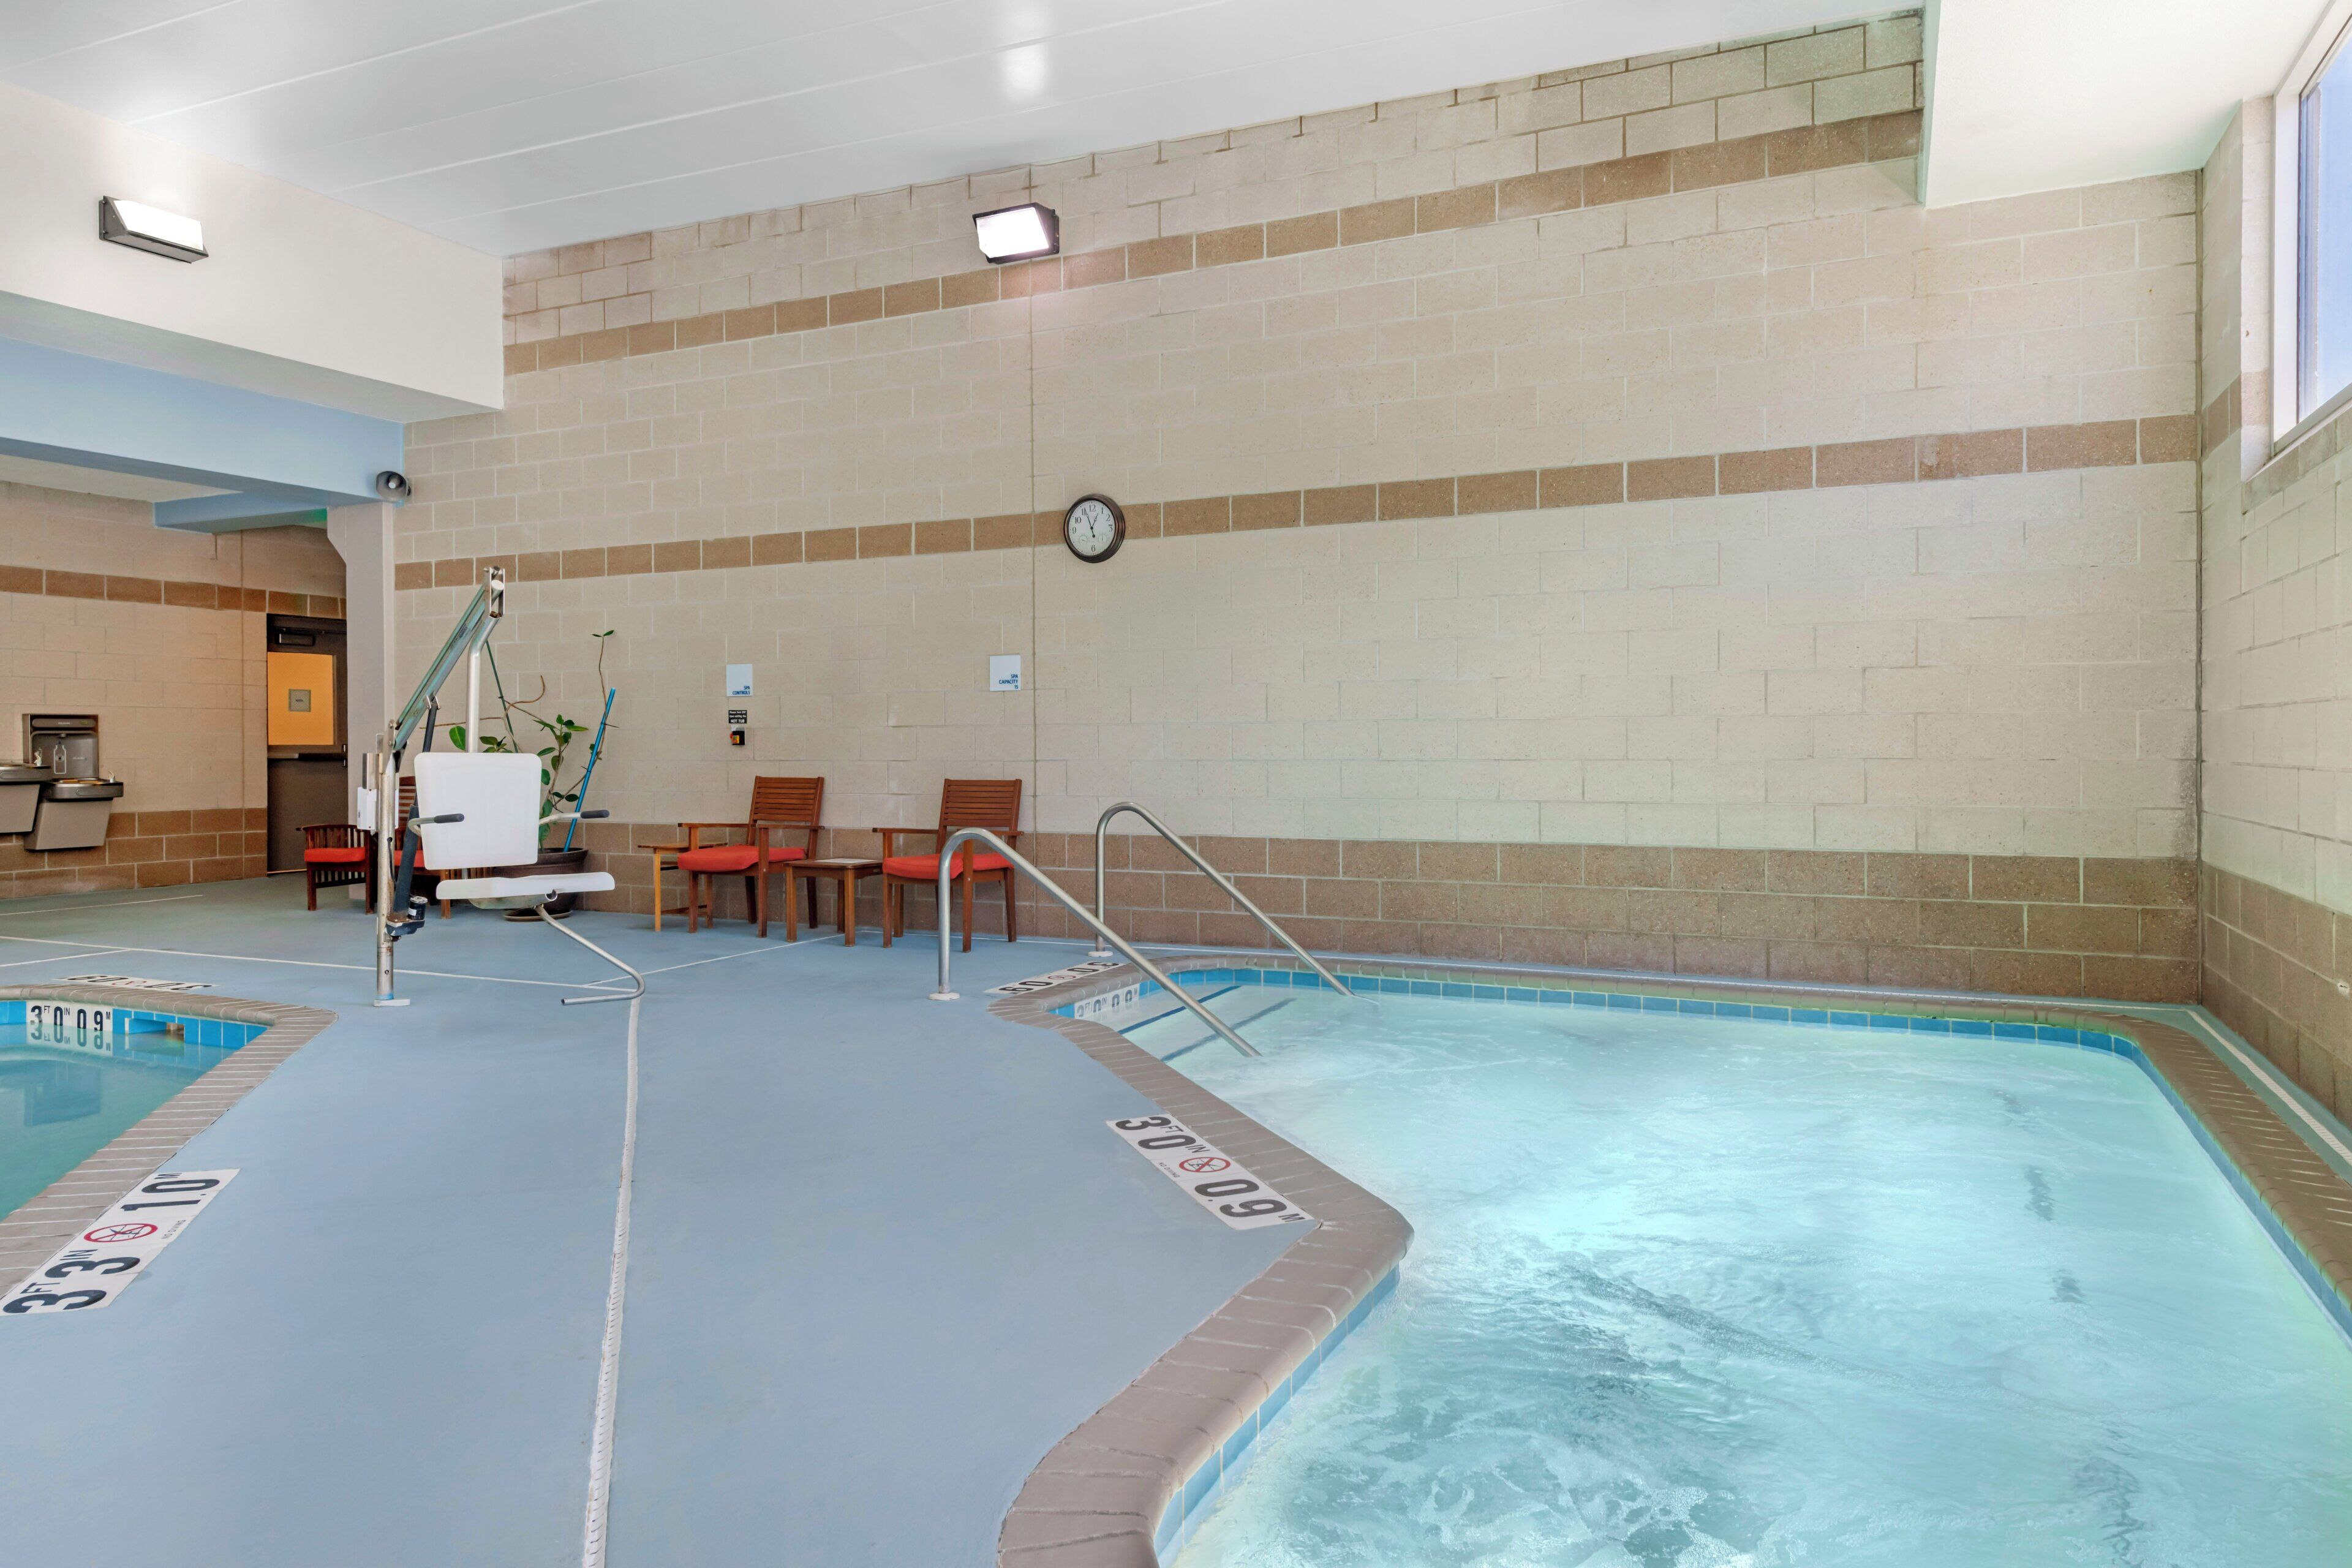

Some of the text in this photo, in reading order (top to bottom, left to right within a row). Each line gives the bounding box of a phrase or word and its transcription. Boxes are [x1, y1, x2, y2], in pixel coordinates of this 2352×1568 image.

[1085, 1001, 1091, 1012] FT
[1102, 997, 1107, 1005] IN
[1134, 987, 1139, 996] M
[31, 1005, 42, 1024] 3
[43, 1005, 50, 1014] FT
[54, 1006, 63, 1026] 0
[64, 1007, 70, 1016] IN
[105, 1011, 111, 1020] M
[1115, 1116, 1172, 1131] 3
[1137, 1134, 1197, 1150] 0
[1185, 1144, 1211, 1154] IN
[1164, 1167, 1180, 1178] DIVING
[1278, 1213, 1306, 1223] M
[167, 1219, 187, 1232] DIVING
[59, 1249, 98, 1261] IN
[45, 1257, 140, 1278] 3
[20, 1282, 61, 1294] FT
[2, 1289, 107, 1314] 3
